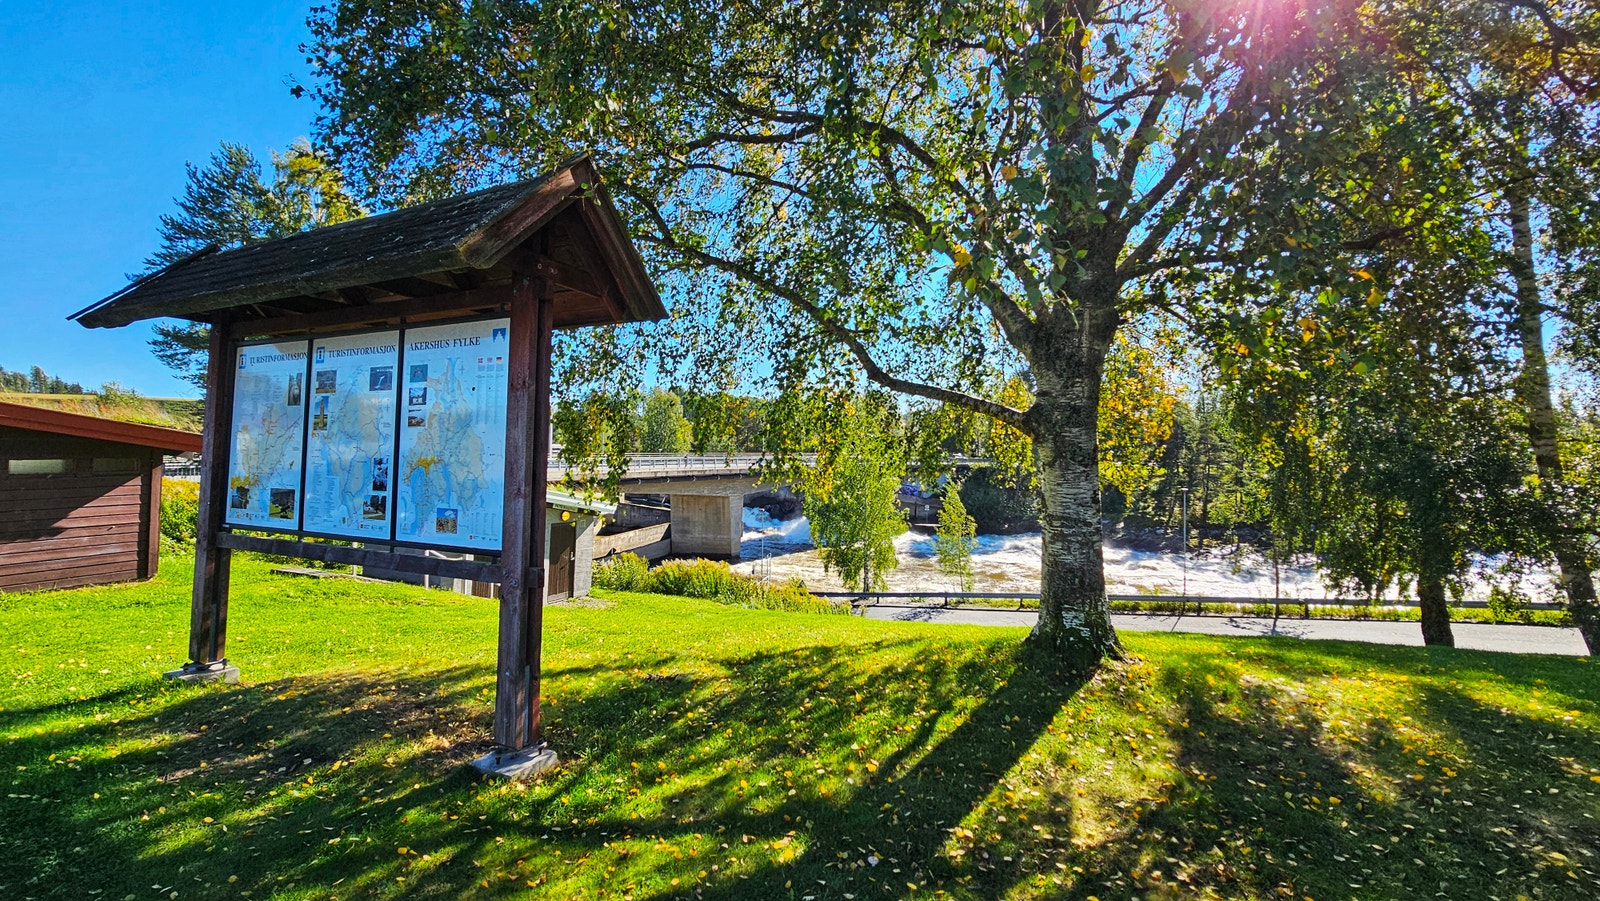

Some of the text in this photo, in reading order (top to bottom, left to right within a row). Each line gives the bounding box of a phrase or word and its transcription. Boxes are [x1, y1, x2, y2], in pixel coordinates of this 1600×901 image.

[408, 336, 481, 351] AKERSHUS FYLKE
[249, 352, 308, 364] TURISTINFORMASJON
[328, 345, 396, 358] TURISTINFORMASJON
